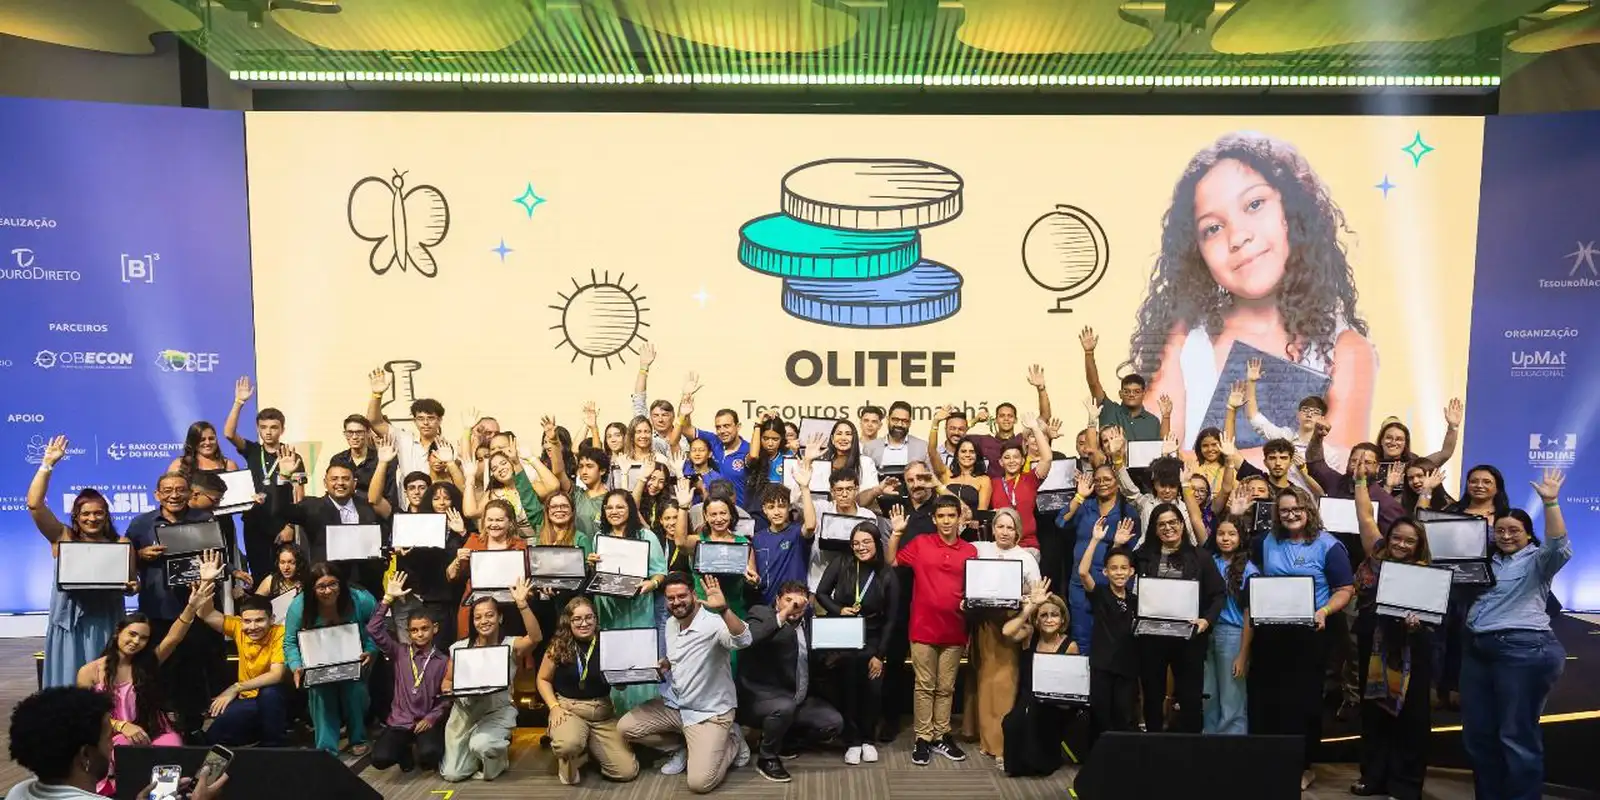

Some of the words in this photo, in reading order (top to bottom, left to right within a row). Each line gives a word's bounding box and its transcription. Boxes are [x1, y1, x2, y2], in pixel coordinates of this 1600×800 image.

[49, 323, 108, 332] PARCEIROS
[1504, 326, 1579, 339] ORGANIZAÇÃO
[60, 352, 133, 364] OBECON
[785, 350, 956, 387] OLITEF
[7, 414, 44, 423] APOIO
[128, 443, 156, 451] BANCO
[143, 450, 170, 458] BRASIL
[1528, 451, 1577, 460] UNDIME
